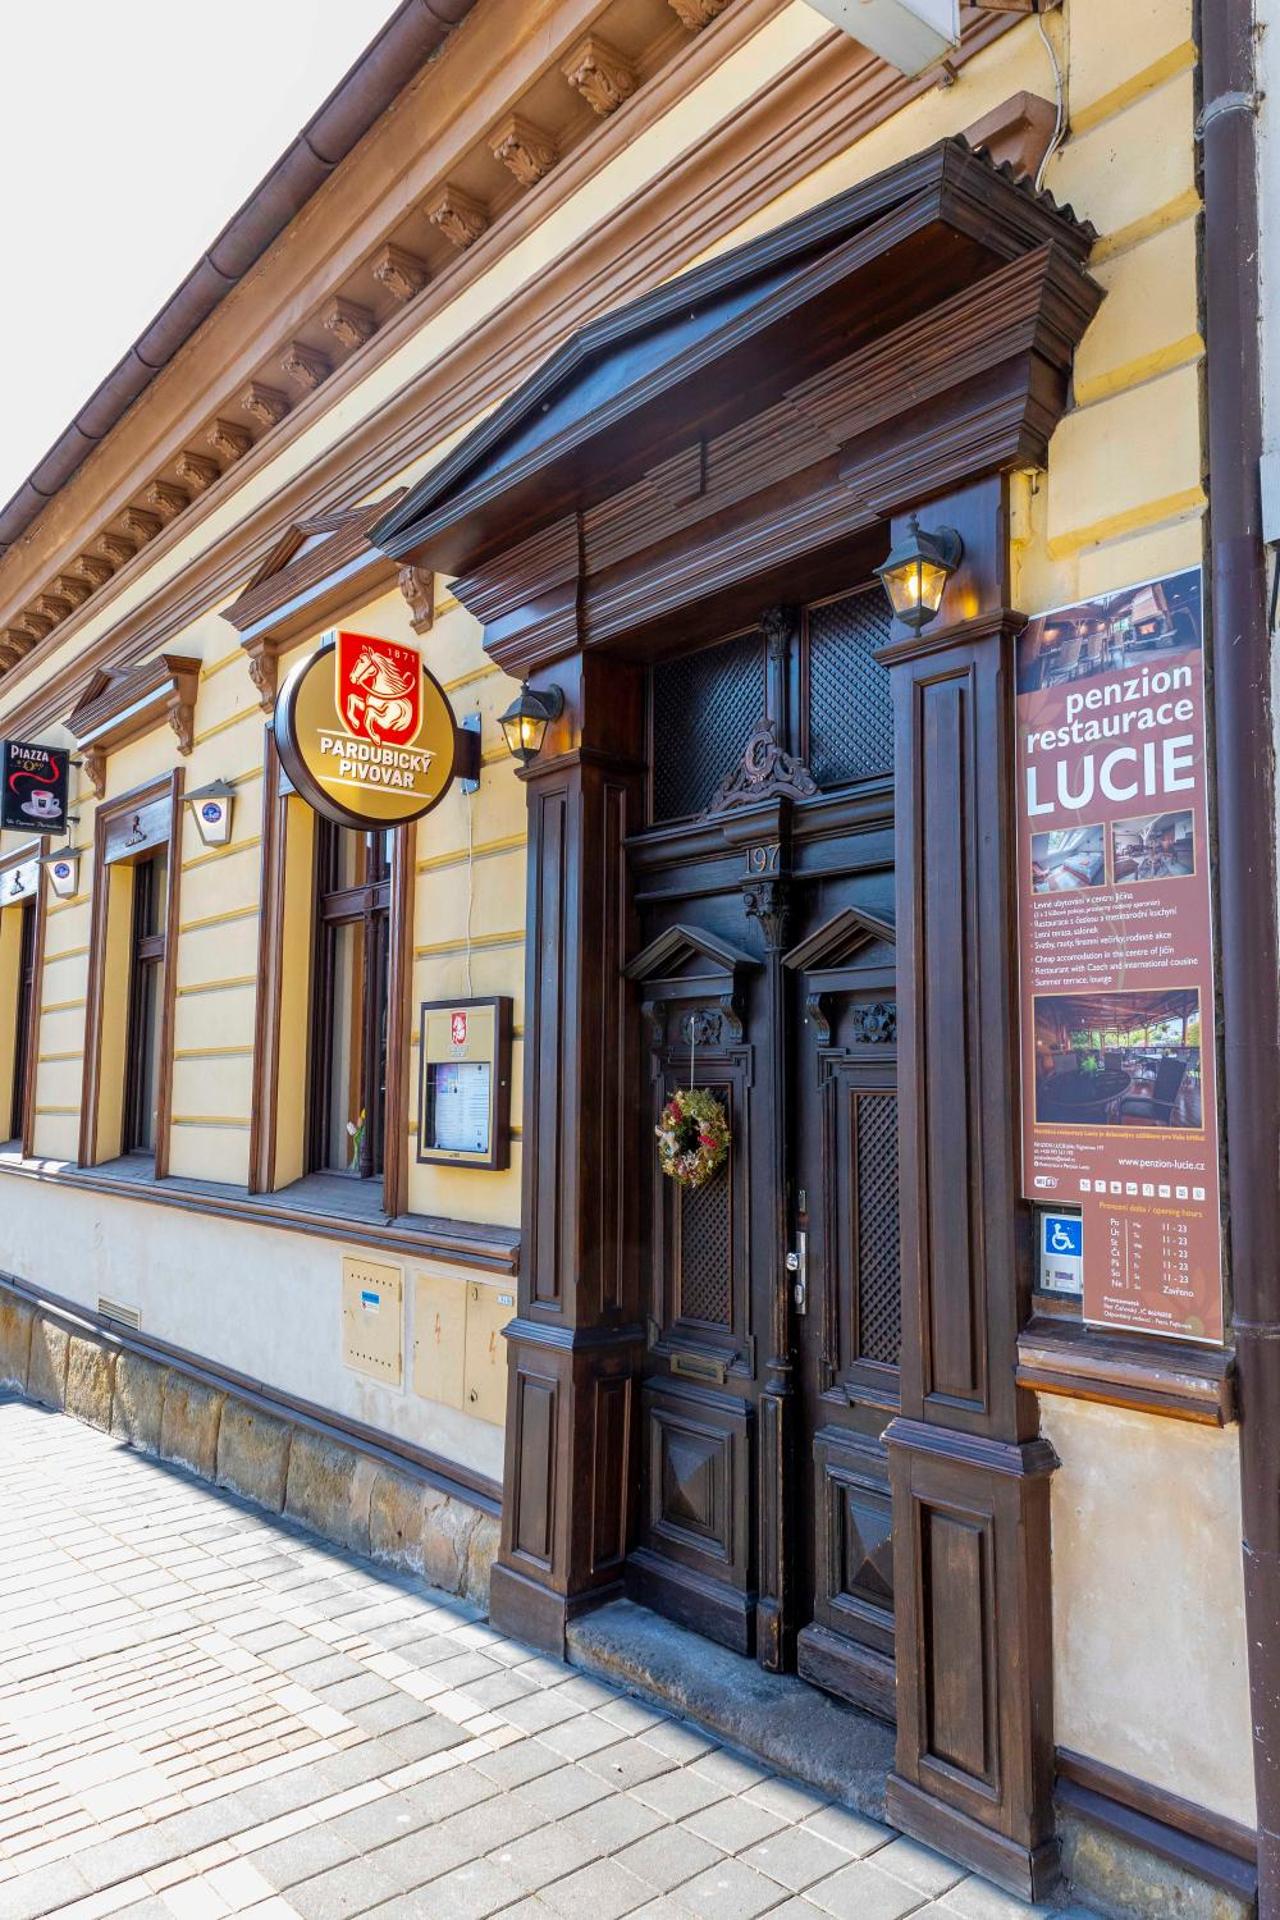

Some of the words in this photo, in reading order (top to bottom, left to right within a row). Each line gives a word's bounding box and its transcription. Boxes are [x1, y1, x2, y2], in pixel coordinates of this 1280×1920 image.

[388, 647, 416, 663] 1871
[1066, 665, 1192, 723] penzion
[1027, 698, 1194, 754] restaurace
[10, 744, 49, 763] PIAZZA
[320, 737, 431, 774] PARDUBICKÝ
[339, 759, 415, 787] PIVOVAR
[1026, 734, 1195, 816] LUCIE
[745, 843, 781, 874] 197
[1035, 955, 1055, 963] Cheap
[1070, 964, 1085, 972] with
[1118, 1158, 1206, 1171] www.penzion-lucie.cz
[1162, 1223, 1170, 1231] 11
[1178, 1224, 1187, 1233] 23
[1162, 1235, 1170, 1244] 11
[1178, 1236, 1188, 1246] 23
[1163, 1248, 1171, 1256] 11
[1178, 1249, 1188, 1258] 23
[1163, 1261, 1171, 1269] 11
[1163, 1273, 1171, 1282] 11
[1180, 1275, 1189, 1284] 23
[1163, 1285, 1194, 1298] Zavřeno
